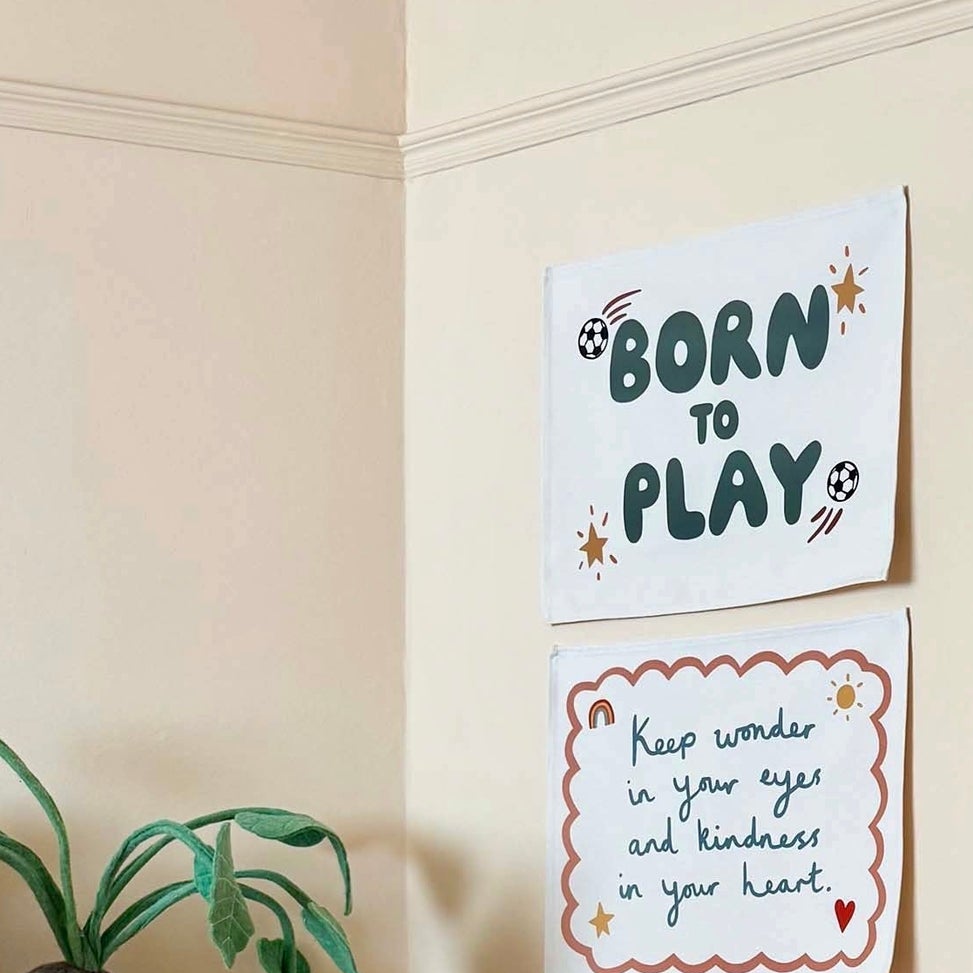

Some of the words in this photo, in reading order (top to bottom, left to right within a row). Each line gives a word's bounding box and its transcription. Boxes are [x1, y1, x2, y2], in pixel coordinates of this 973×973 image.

[609, 284, 830, 403] BORN
[689, 399, 739, 445] TO
[623, 440, 822, 544] PLAY
[631, 714, 697, 767] Keep
[715, 707, 816, 749] wonder
[626, 780, 656, 806] in
[673, 774, 739, 822] your
[759, 767, 822, 818] eyes
[628, 817, 679, 856] and
[697, 816, 821, 851] kindness
[618, 873, 643, 900] in
[661, 878, 720, 928] your
[743, 861, 832, 898] heart.
